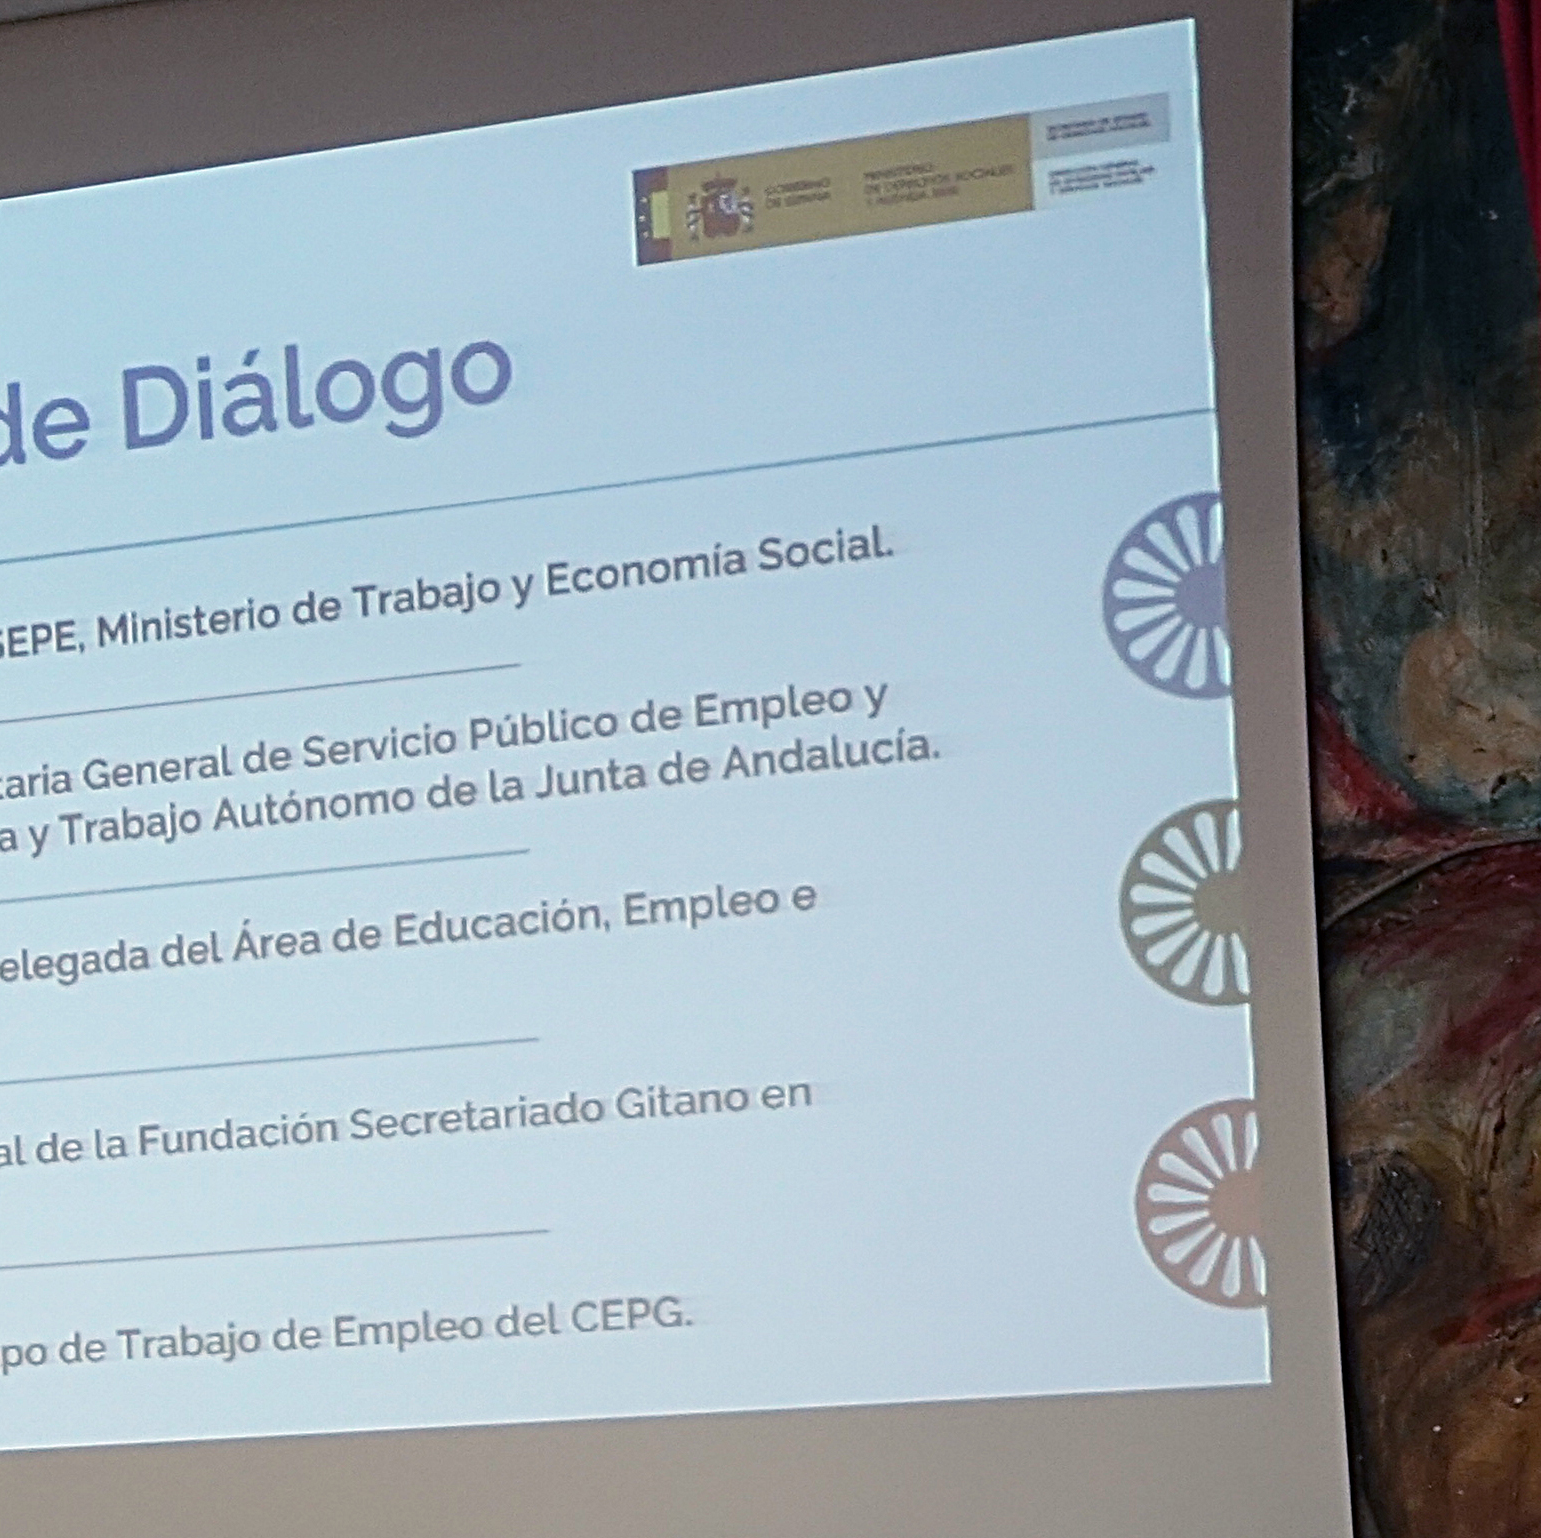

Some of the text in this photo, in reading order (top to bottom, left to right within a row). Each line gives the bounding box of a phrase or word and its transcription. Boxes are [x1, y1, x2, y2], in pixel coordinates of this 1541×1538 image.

[121, 339, 513, 452] Diálogo
[96, 596, 282, 649] Ministerio
[291, 589, 343, 626] de
[350, 571, 502, 618] Trabajo
[510, 572, 535, 611] y
[546, 542, 748, 597] Economía
[758, 523, 895, 572] Social.
[82, 744, 235, 791] General
[242, 740, 293, 775] de
[302, 722, 458, 769] Servicio
[469, 707, 619, 752] Público
[629, 698, 684, 735] de
[694, 683, 854, 730] Empleo
[863, 682, 889, 720] y
[27, 822, 50, 860] y
[57, 801, 203, 847] Trabajo
[212, 786, 416, 832] Autónomo
[426, 773, 479, 810] de
[488, 767, 526, 805] la
[534, 758, 648, 800] Junta
[657, 750, 712, 787] de
[721, 726, 941, 781] Andalucía.
[160, 930, 224, 969] del
[231, 918, 323, 963] Área
[331, 917, 383, 954] de
[394, 897, 611, 948] Educación,
[623, 883, 781, 931] Empleo
[791, 884, 818, 912] e
[34, 1131, 85, 1165] de
[93, 1128, 129, 1161] la
[138, 1111, 340, 1157] Fundación
[349, 1091, 606, 1141] Secretariado
[615, 1084, 750, 1120] Gitano
[760, 1082, 812, 1111] en
[58, 1331, 108, 1366] de
[115, 1320, 263, 1364] Trabajo
[272, 1317, 323, 1352] de
[333, 1309, 485, 1354] Empleo
[494, 1301, 562, 1339] del
[571, 1294, 694, 1333] CEPG.
